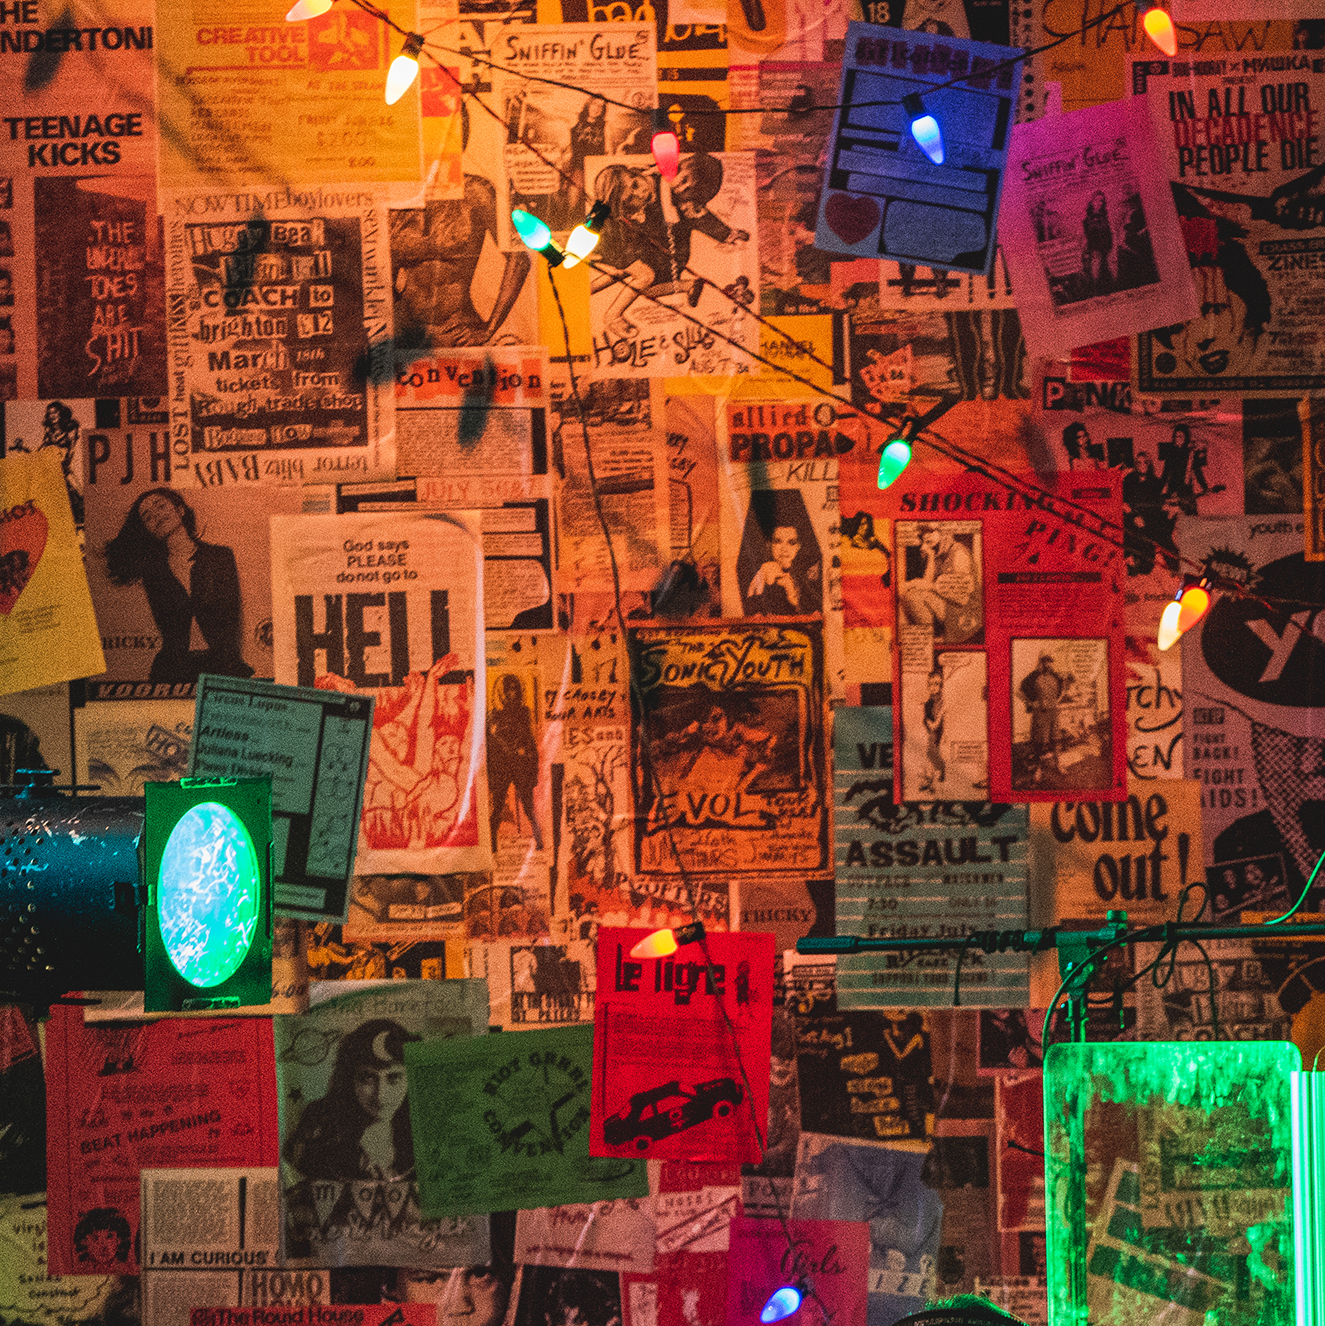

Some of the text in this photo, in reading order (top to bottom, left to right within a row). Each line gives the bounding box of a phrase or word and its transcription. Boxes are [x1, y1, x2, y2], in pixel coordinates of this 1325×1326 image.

[0, 27, 152, 52] NDERTON
[196, 27, 306, 45] CREATIVE
[245, 47, 306, 63] TOOL
[1170, 83, 1310, 120] IN ALL OUR
[3, 114, 141, 139] TEENAGE
[1173, 111, 1319, 147] DECADENCE
[28, 142, 120, 166] KICKS
[1176, 137, 1319, 176] PEOPLE DIE
[593, 336, 655, 367] HOLE
[1250, 521, 1295, 537] youth
[343, 540, 409, 553] God says
[347, 555, 406, 567] PLEASE
[102, 634, 161, 650] RICKY
[1194, 769, 1244, 785] FIGHT
[1050, 793, 1168, 844] come
[847, 835, 1019, 867] ASSAULT
[159, 1251, 186, 1265] AM
[217, 1307, 248, 1325] The
[306, 1308, 364, 1326] House
